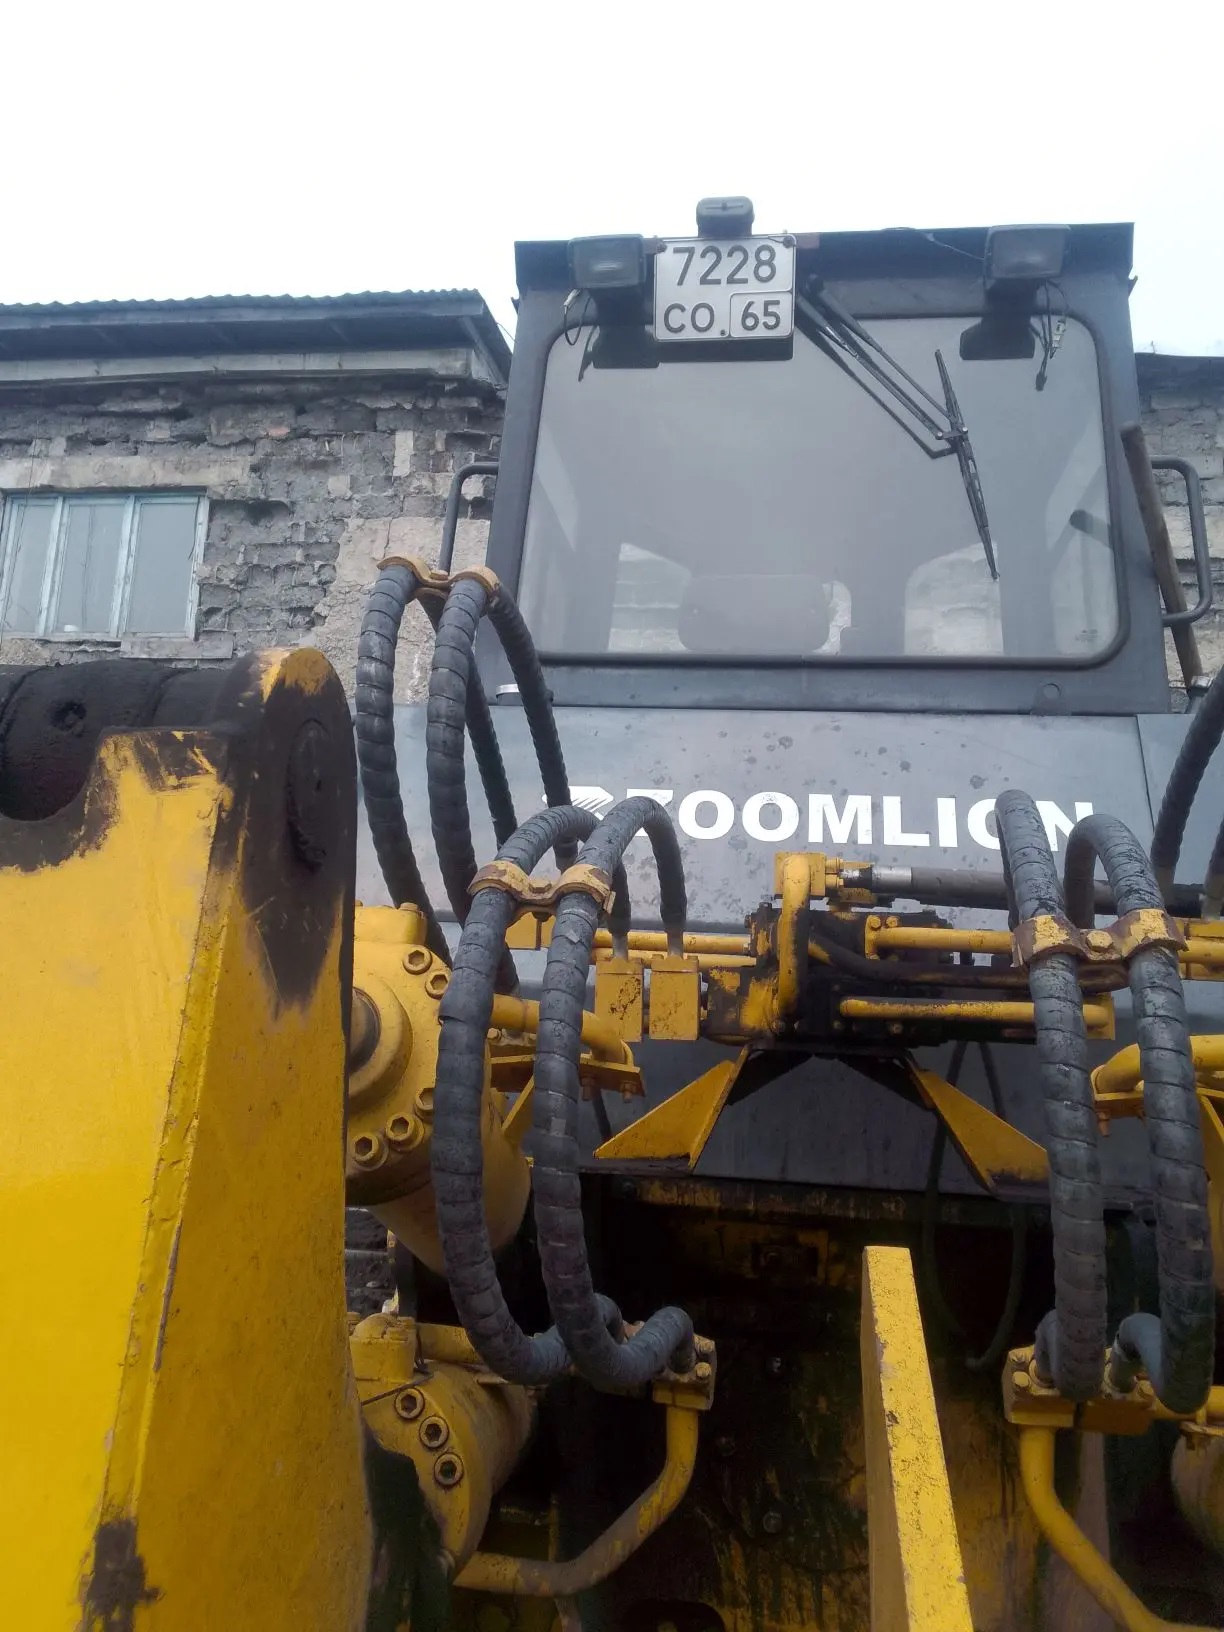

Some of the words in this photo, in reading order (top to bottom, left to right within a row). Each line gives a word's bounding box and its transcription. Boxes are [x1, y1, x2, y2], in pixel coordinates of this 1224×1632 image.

[672, 244, 777, 286] 7228
[663, 302, 715, 334] CO
[740, 299, 781, 332] 65
